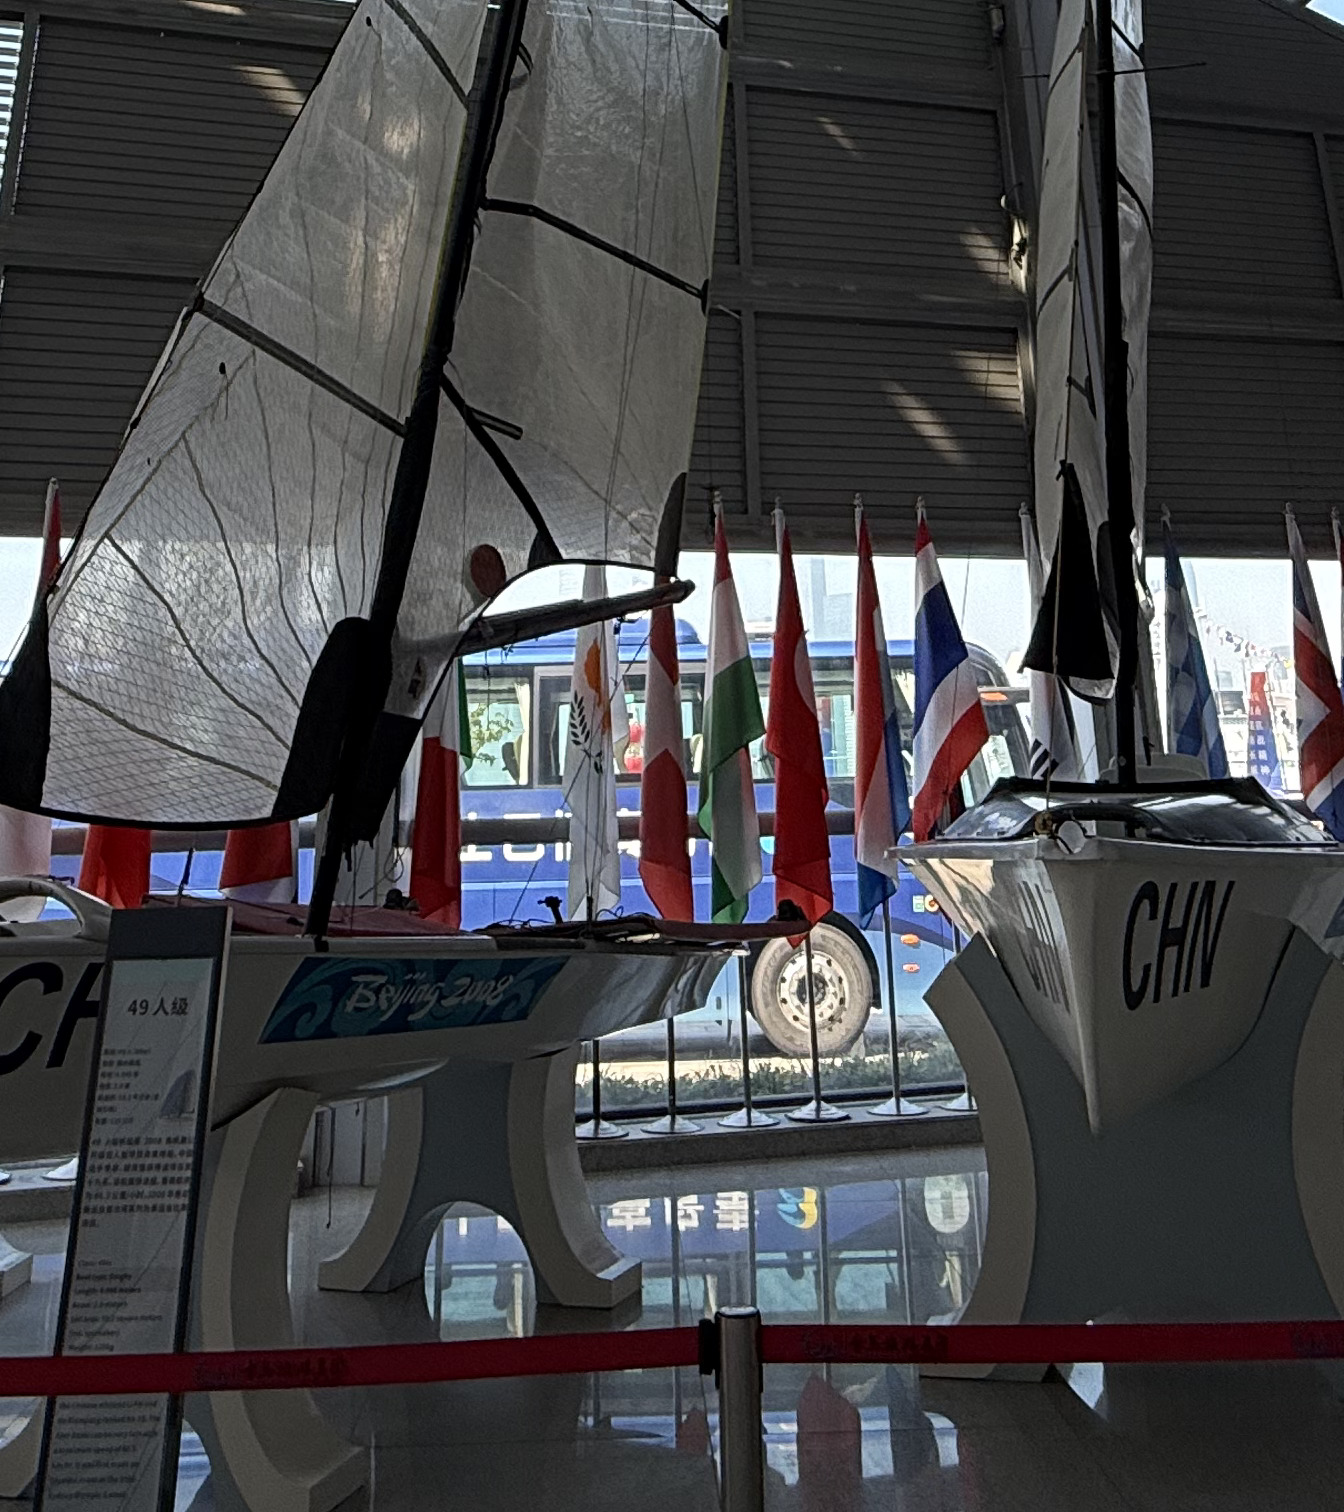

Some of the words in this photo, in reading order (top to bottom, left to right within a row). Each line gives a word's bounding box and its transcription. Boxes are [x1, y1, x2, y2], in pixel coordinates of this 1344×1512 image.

[1122, 878, 1234, 1010] CHN
[346, 972, 447, 1020] Beijing
[441, 973, 513, 1007] 2008
